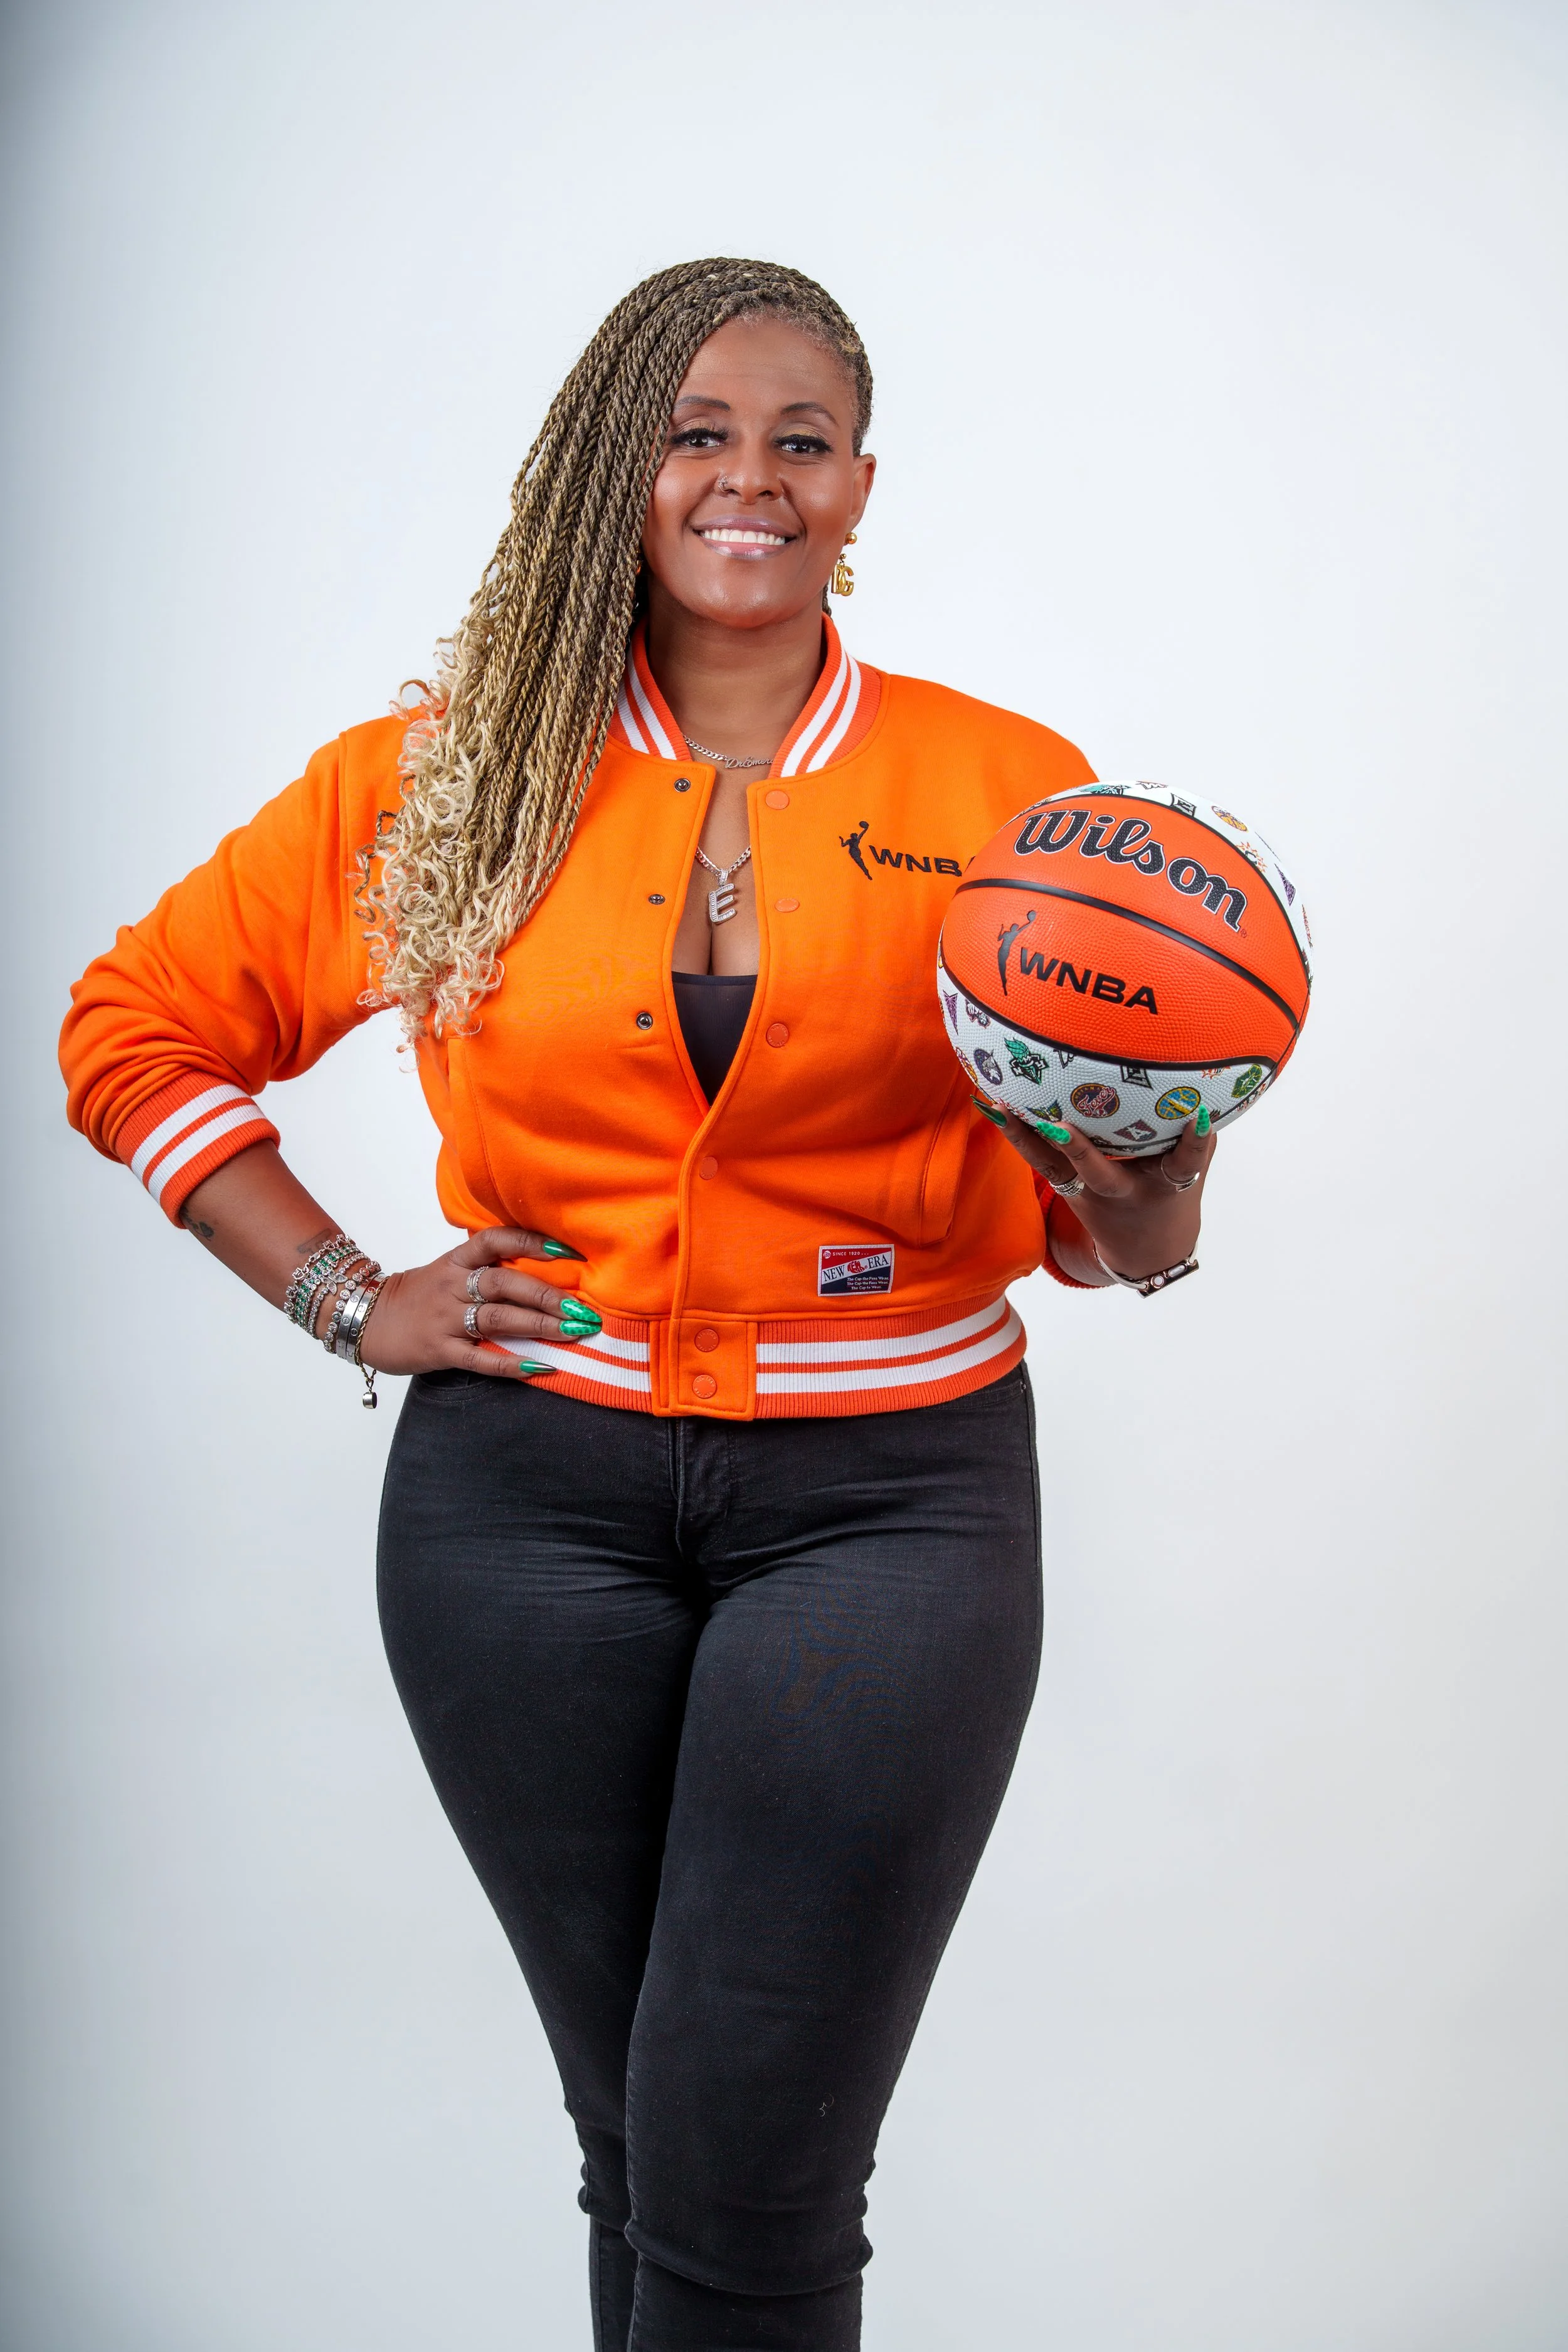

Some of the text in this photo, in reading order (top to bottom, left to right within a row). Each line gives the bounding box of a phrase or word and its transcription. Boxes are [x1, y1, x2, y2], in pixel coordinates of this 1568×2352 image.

[869, 845, 975, 877] WNB
[1014, 809, 1248, 932] Wilson
[708, 883, 736, 924] E
[1020, 946, 1158, 1015] WNBA
[1078, 1086, 1116, 1117] Fever
[823, 1264, 845, 1281] NEW
[867, 1254, 889, 1269] ERA
